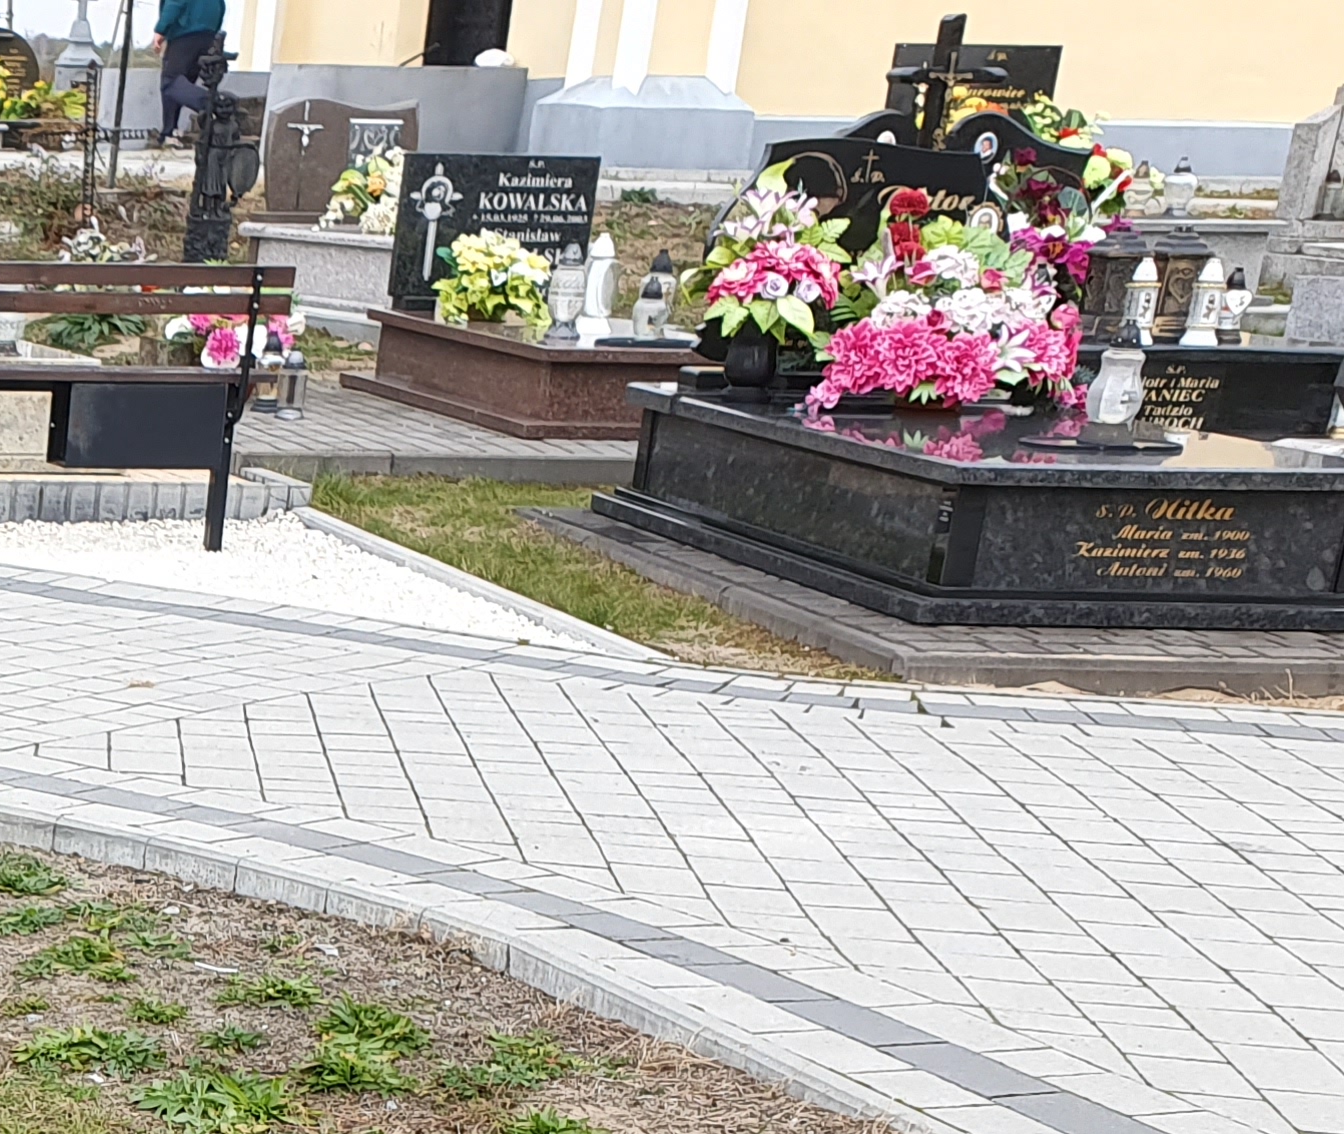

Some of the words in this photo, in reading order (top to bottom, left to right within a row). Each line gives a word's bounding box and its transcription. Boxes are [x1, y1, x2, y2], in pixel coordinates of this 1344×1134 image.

[498, 172, 573, 188] Kazimiera
[479, 191, 588, 212] KOWALSKA
[494, 228, 562, 242] Stanisław
[1177, 376, 1220, 389] Maria
[1113, 524, 1174, 541] Maria
[1213, 530, 1250, 541] 1900
[1072, 541, 1171, 558] Kazimierz
[1096, 561, 1168, 577] Antoni
